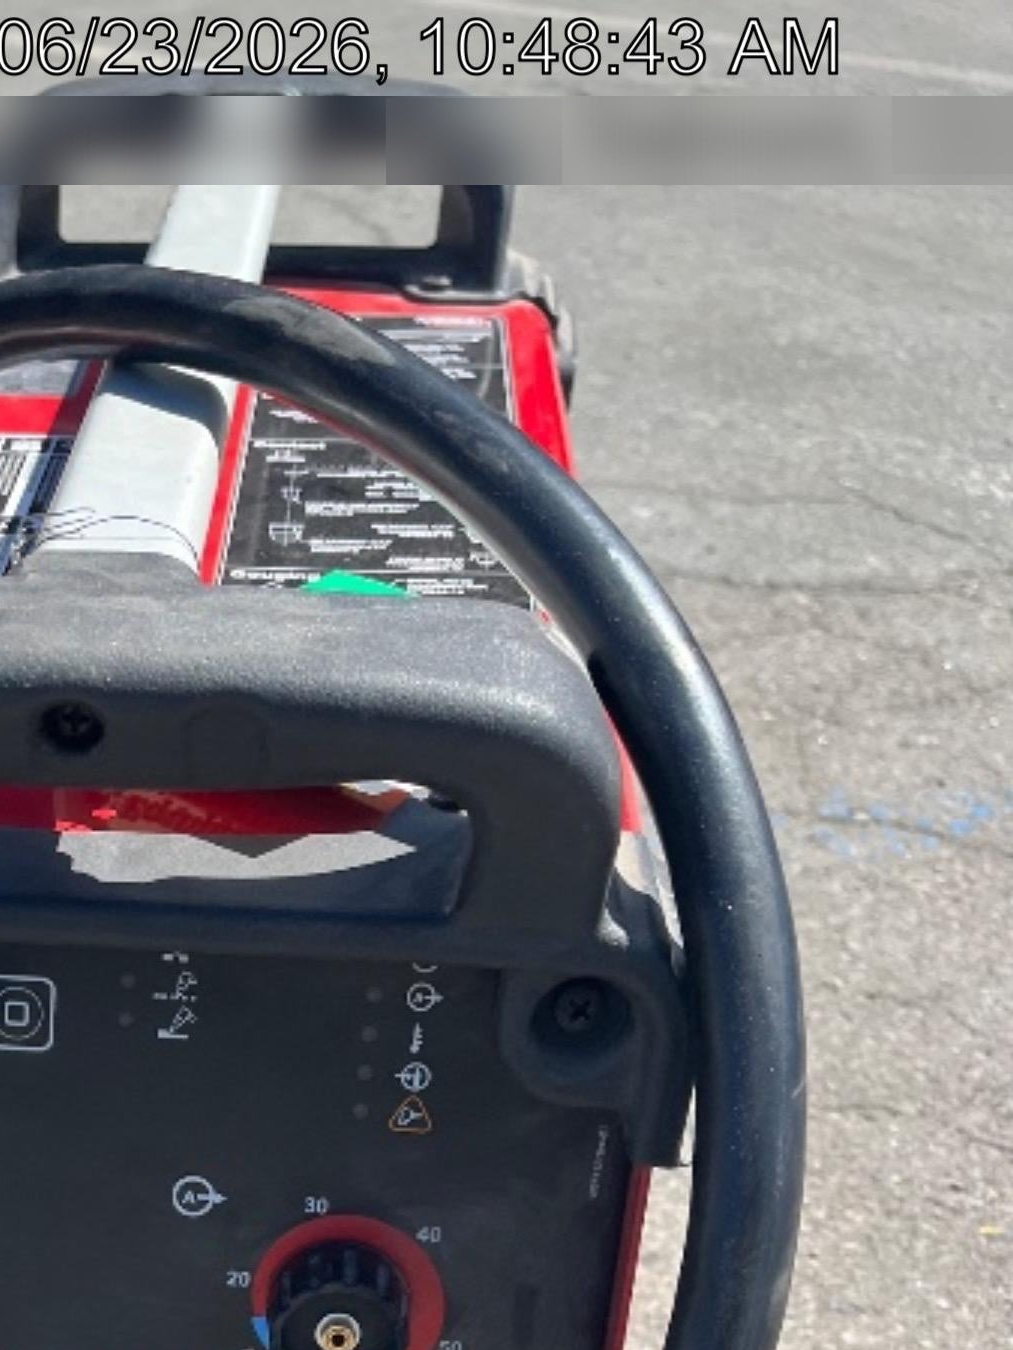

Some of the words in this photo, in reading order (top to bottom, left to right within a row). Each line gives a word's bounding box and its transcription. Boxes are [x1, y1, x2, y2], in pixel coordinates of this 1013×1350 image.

[304, 1196, 329, 1214] 30
[415, 1226, 442, 1243] 40
[226, 1271, 252, 1288] 20
